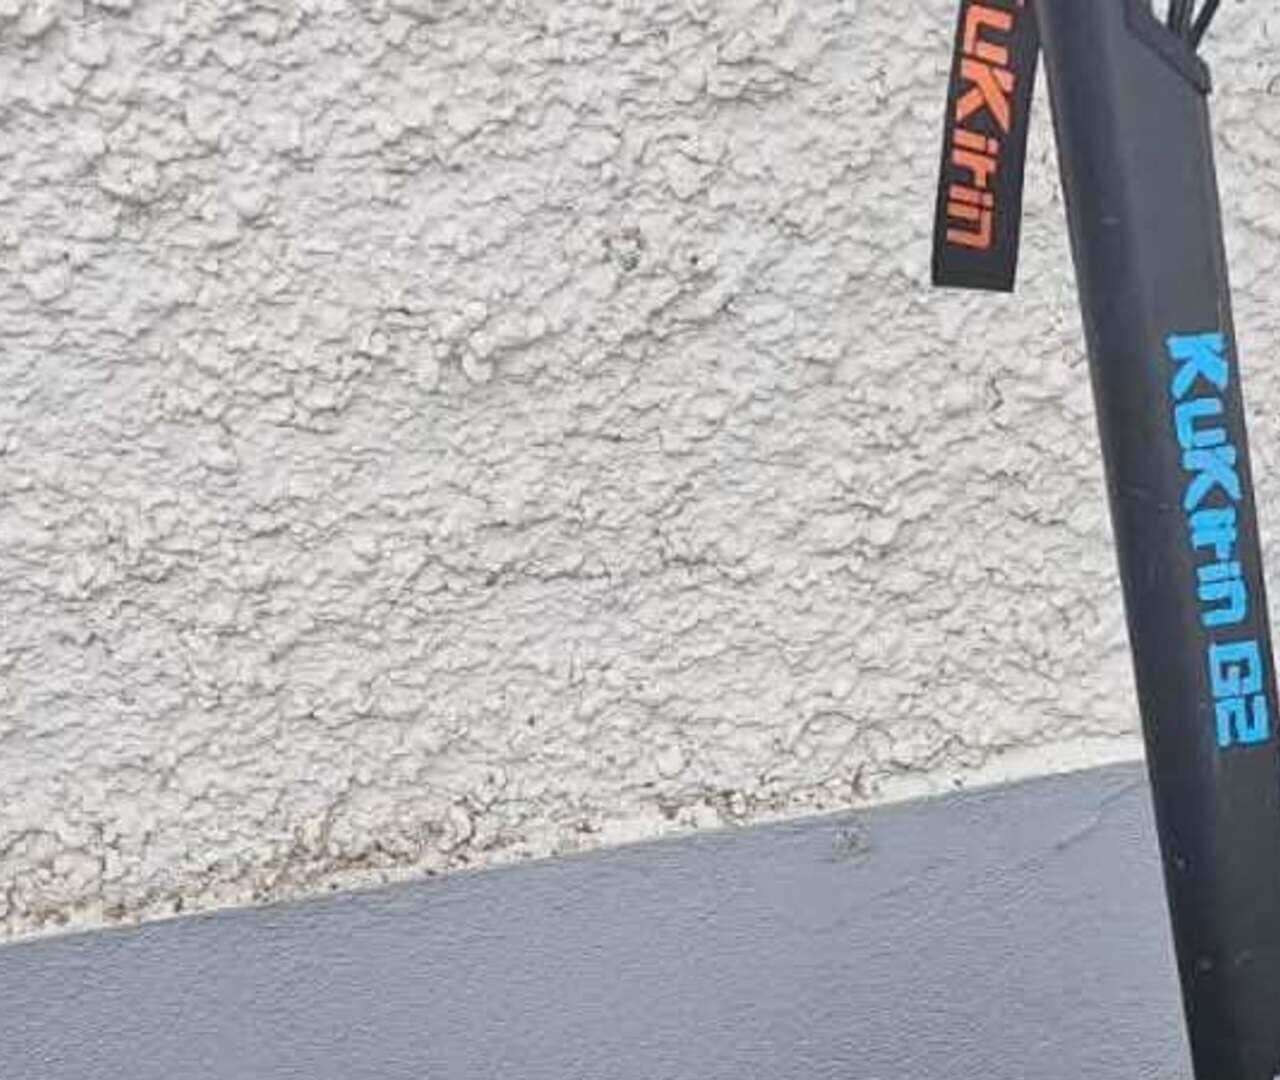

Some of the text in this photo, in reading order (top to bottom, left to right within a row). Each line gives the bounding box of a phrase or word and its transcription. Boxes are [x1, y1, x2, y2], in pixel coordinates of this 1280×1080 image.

[946, 0, 1024, 249] uKirin
[1165, 332, 1270, 748] KuKirin G2
